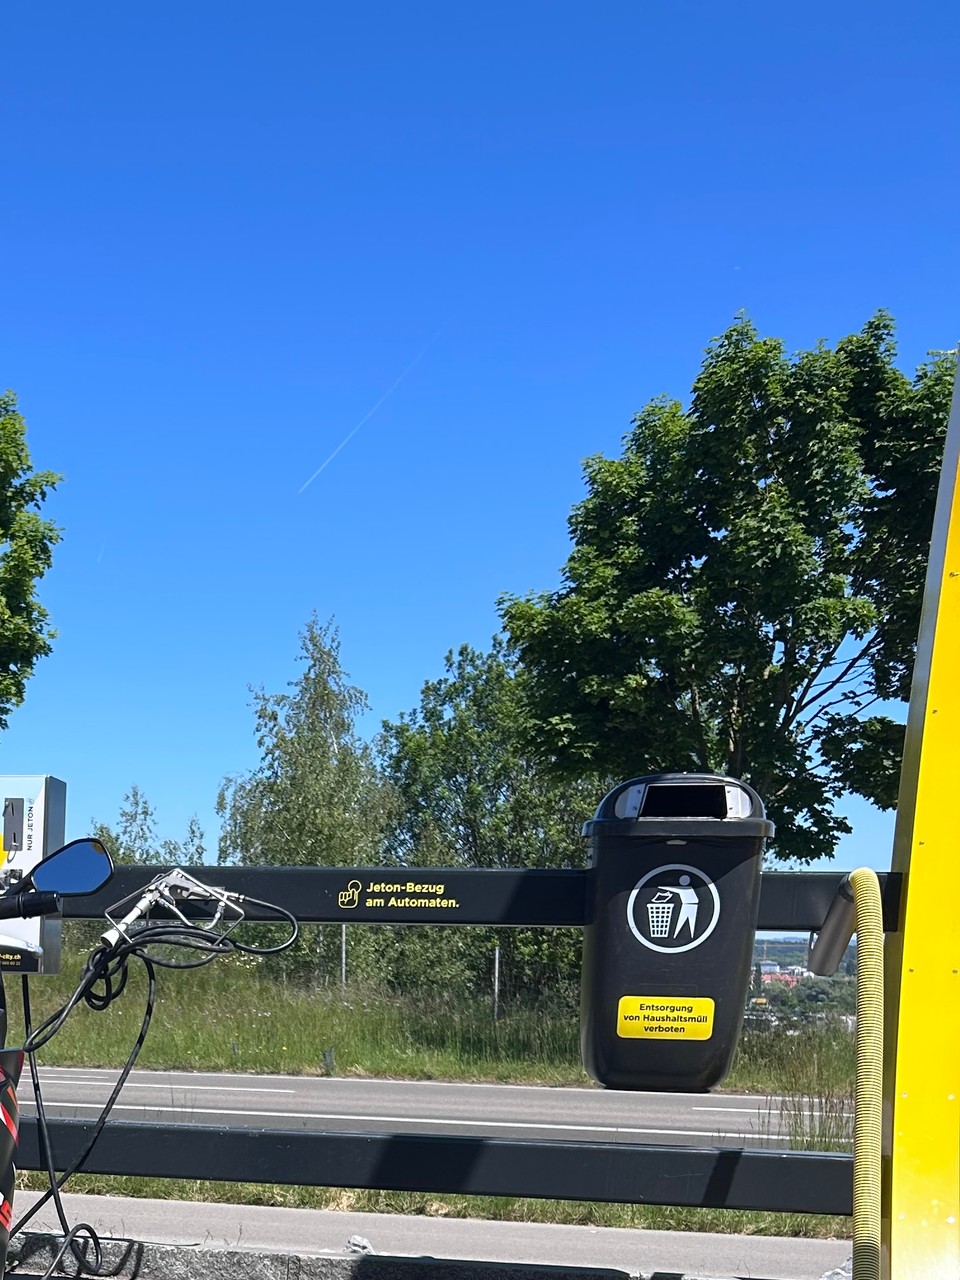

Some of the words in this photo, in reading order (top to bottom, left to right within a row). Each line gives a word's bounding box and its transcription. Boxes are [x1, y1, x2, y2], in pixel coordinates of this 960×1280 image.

[26, 806, 34, 832] JETON
[366, 882, 445, 895] Jeton-Bezug
[365, 898, 385, 907] am
[387, 897, 460, 908] Automaten.
[639, 1003, 693, 1013] Entsorgung
[642, 1014, 708, 1023] Haushaltsmüll
[643, 1025, 686, 1033] verboten
